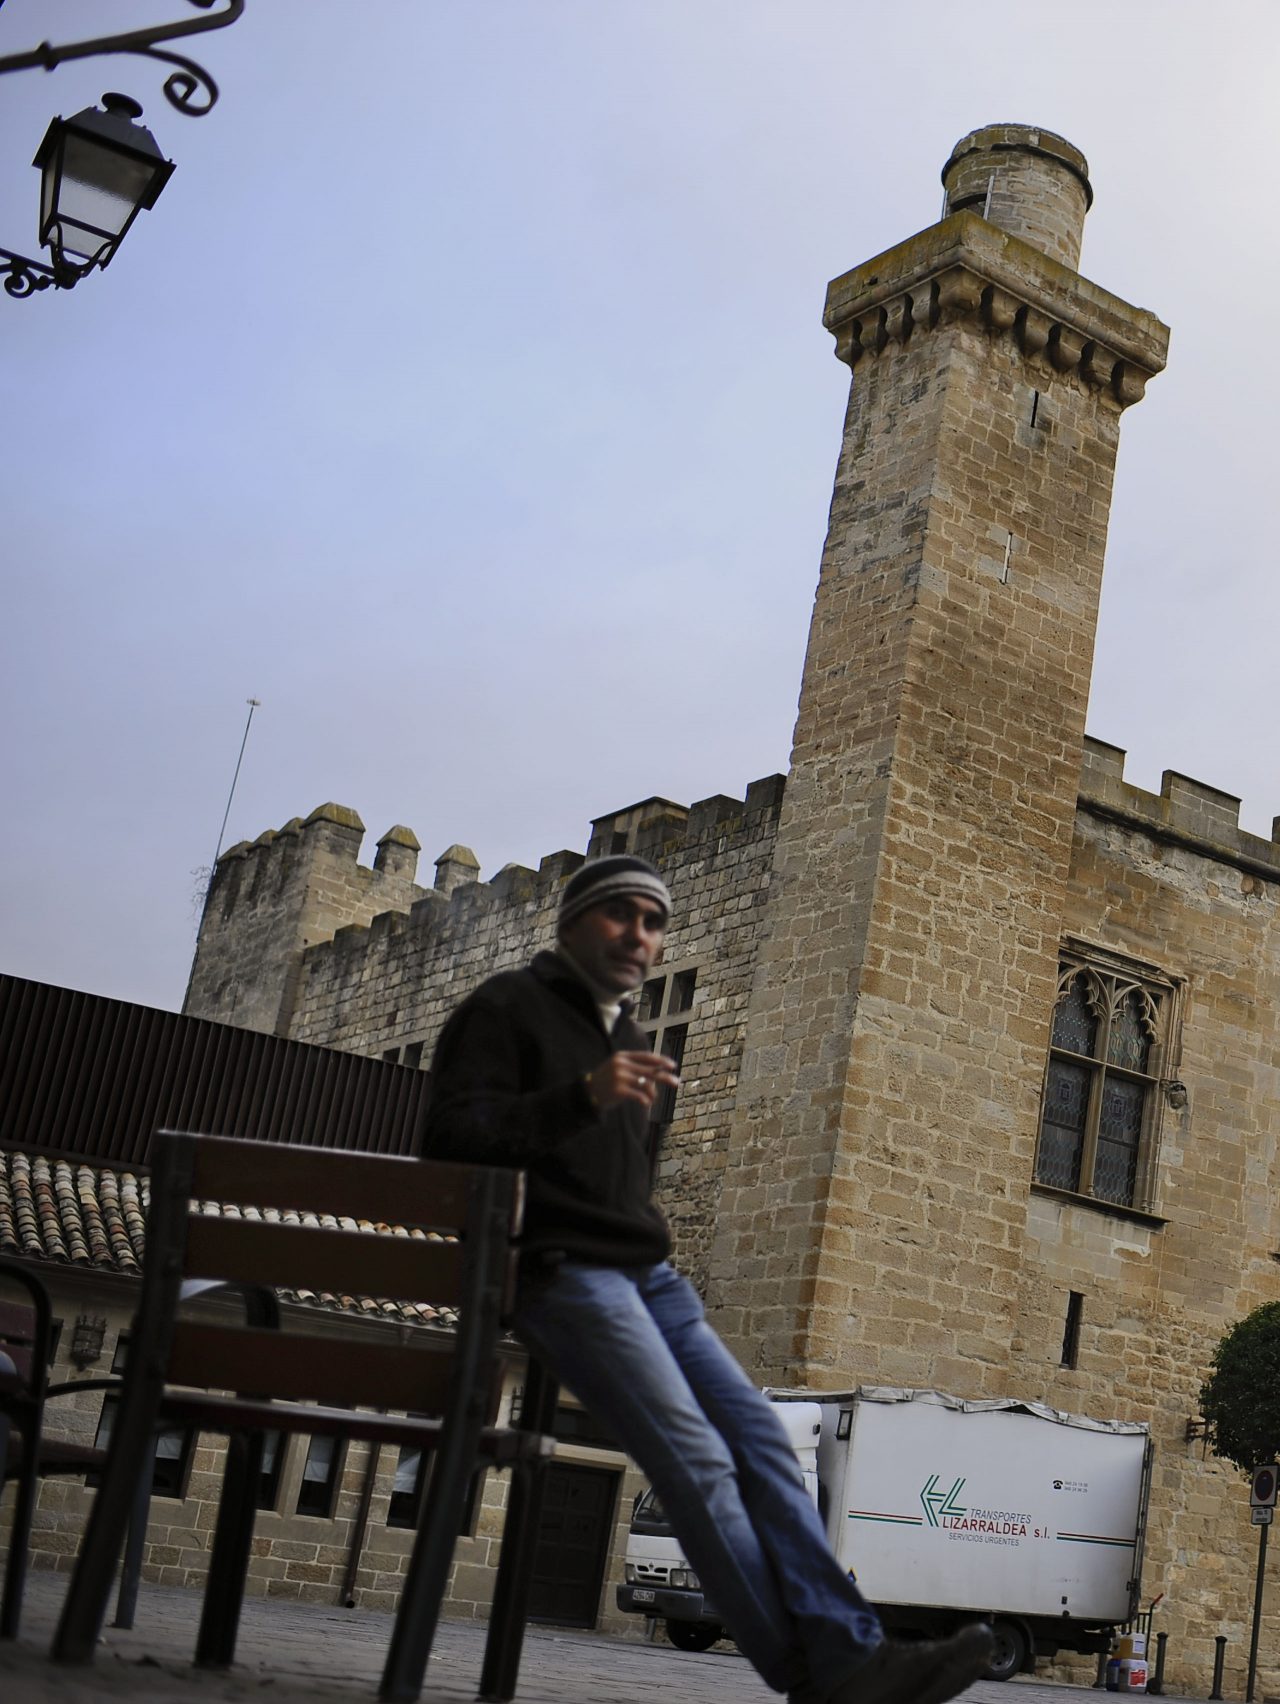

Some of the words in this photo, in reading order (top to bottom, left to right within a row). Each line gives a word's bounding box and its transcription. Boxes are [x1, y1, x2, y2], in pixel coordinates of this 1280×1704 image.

[970, 1508, 1032, 1524] TRANSPORTES
[942, 1516, 1027, 1536] LIZARRALDEA
[948, 1532, 983, 1543] SERVICIOS
[984, 1536, 1020, 1547] URGENTES
